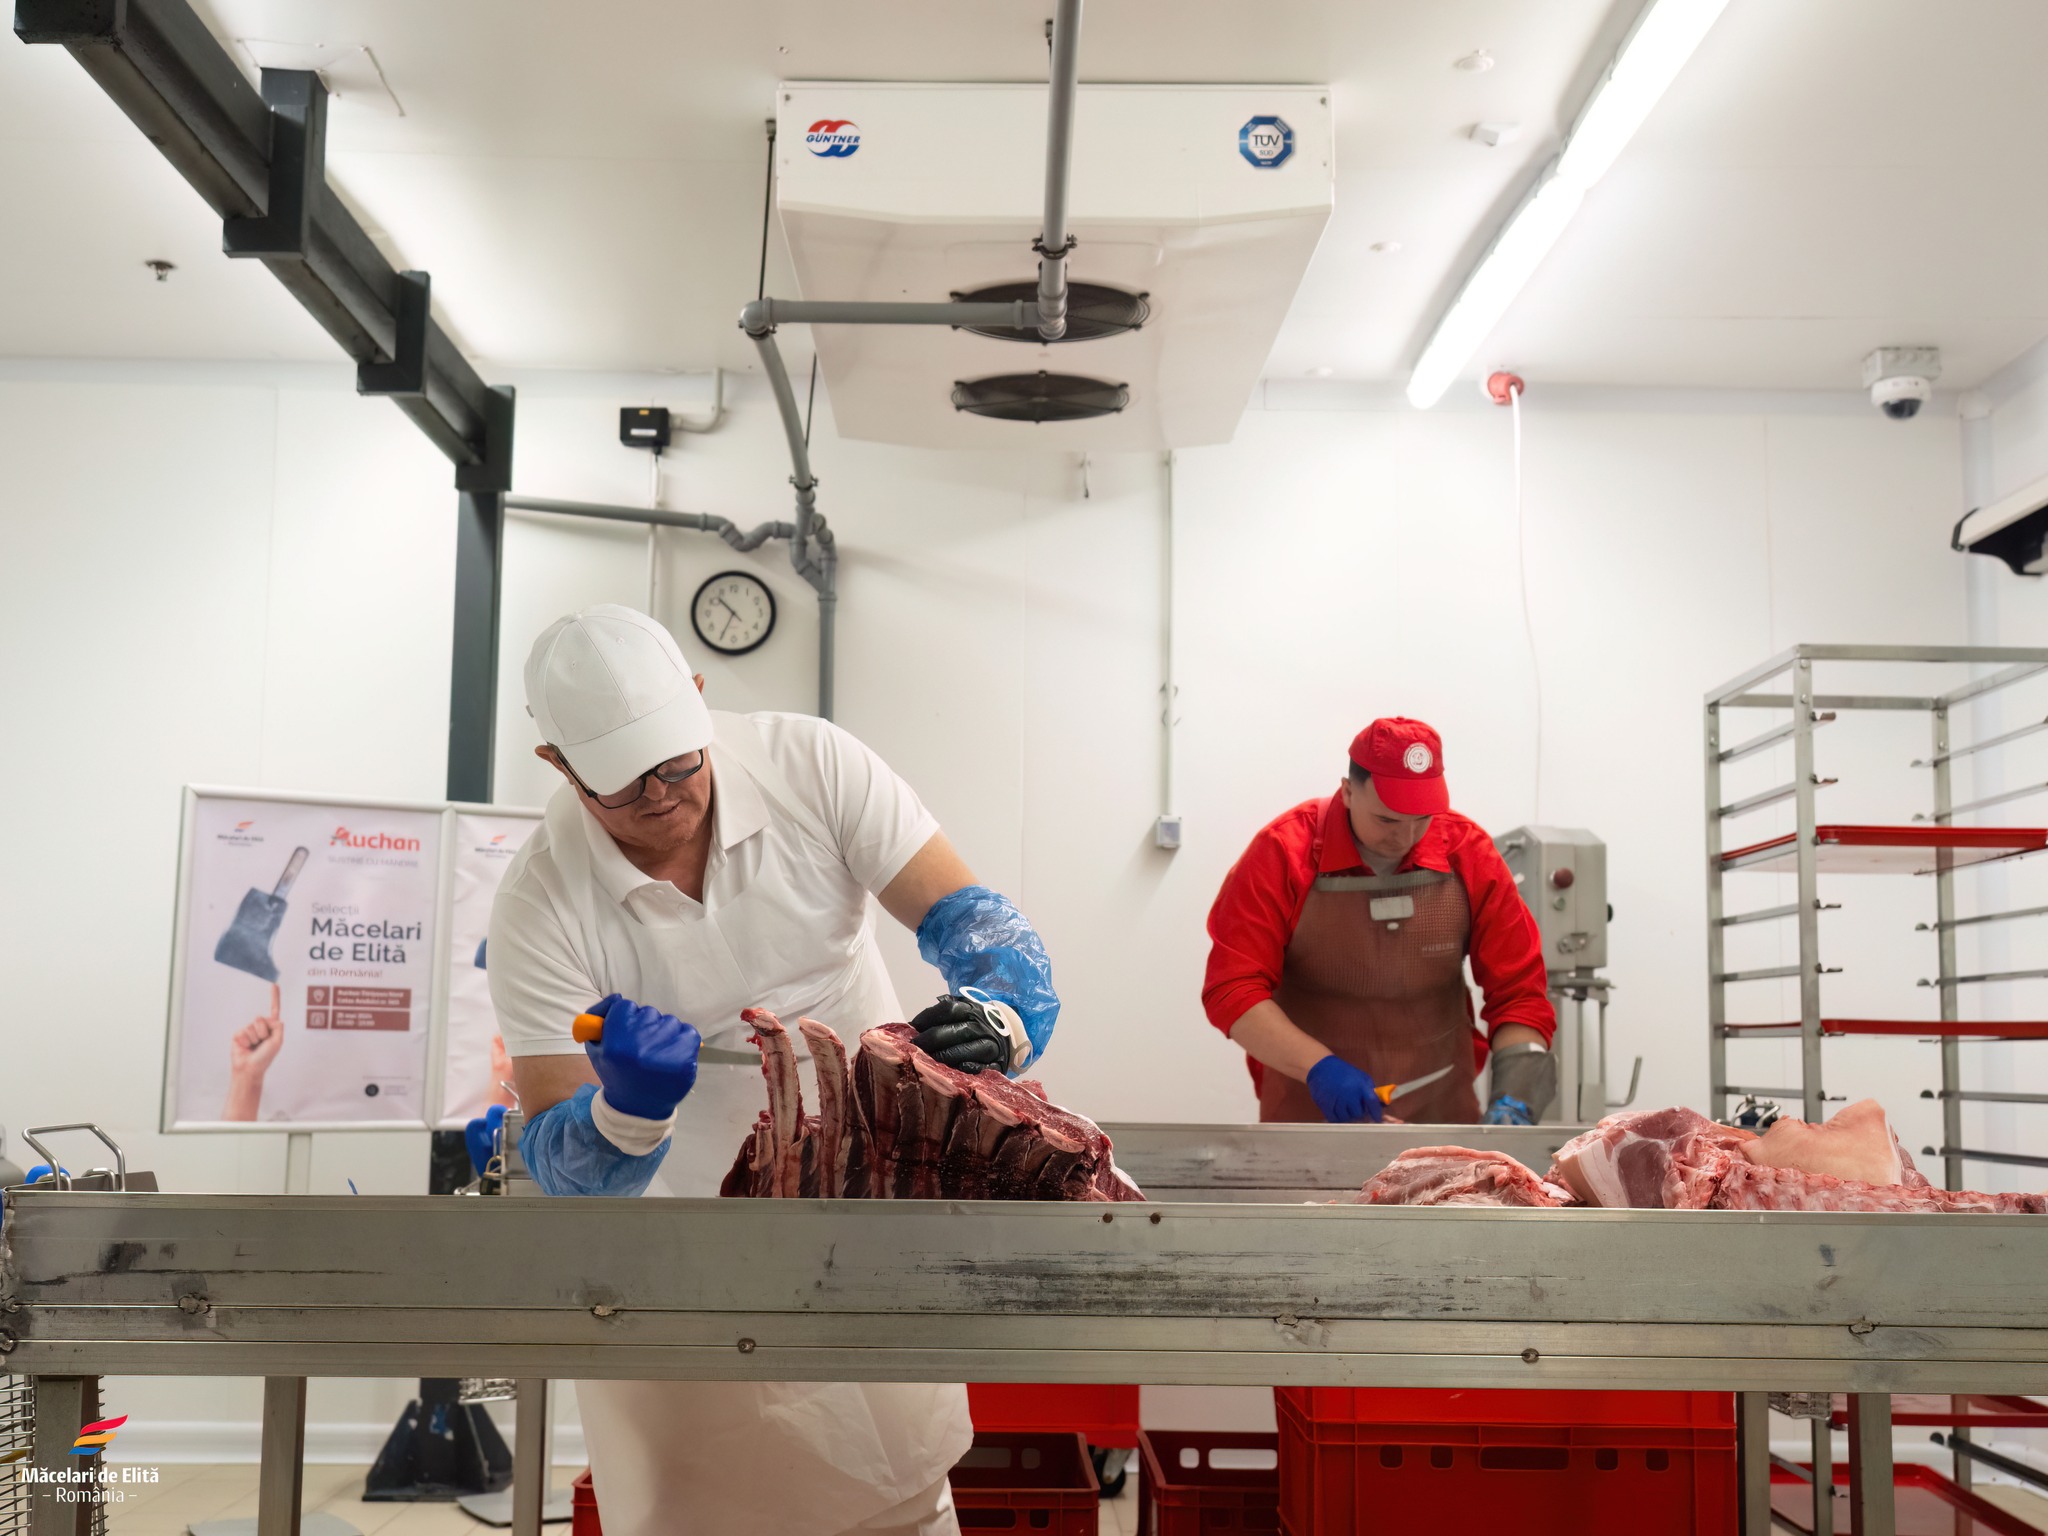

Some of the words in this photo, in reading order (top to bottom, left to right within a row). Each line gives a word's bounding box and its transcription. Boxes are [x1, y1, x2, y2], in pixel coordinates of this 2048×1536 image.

[329, 826, 421, 852] Auchan
[310, 917, 422, 941] Măcelari
[308, 940, 344, 961] de
[352, 942, 407, 964] Elită
